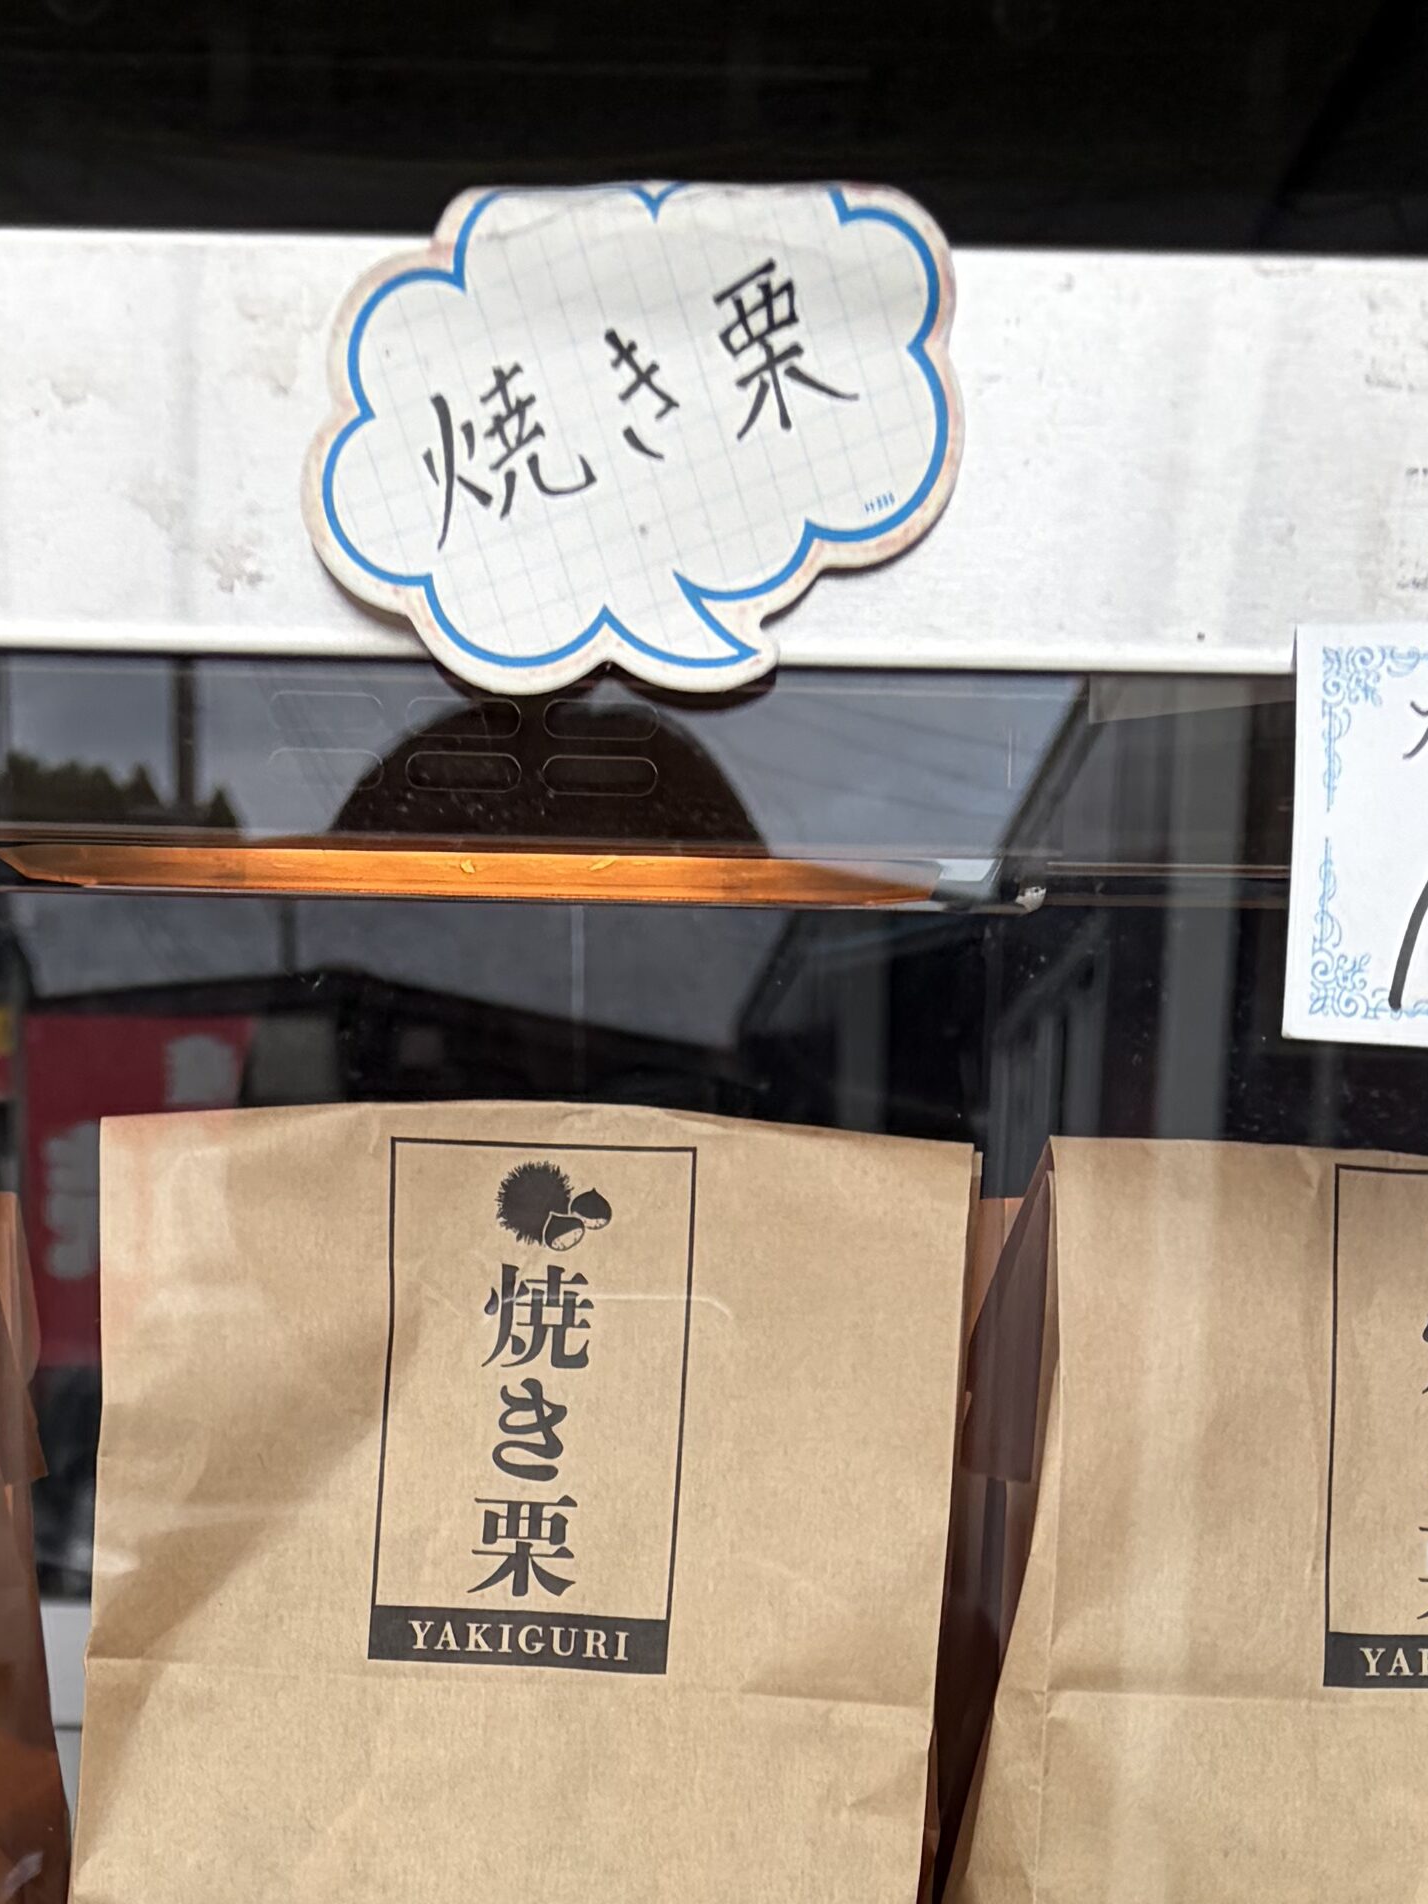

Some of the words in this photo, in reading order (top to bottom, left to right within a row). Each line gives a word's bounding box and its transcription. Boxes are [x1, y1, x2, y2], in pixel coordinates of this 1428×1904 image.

[422, 260, 859, 550] 焼き栗
[466, 1263, 595, 1598] 焼き栗
[409, 1618, 631, 1662] YAKIGURI
